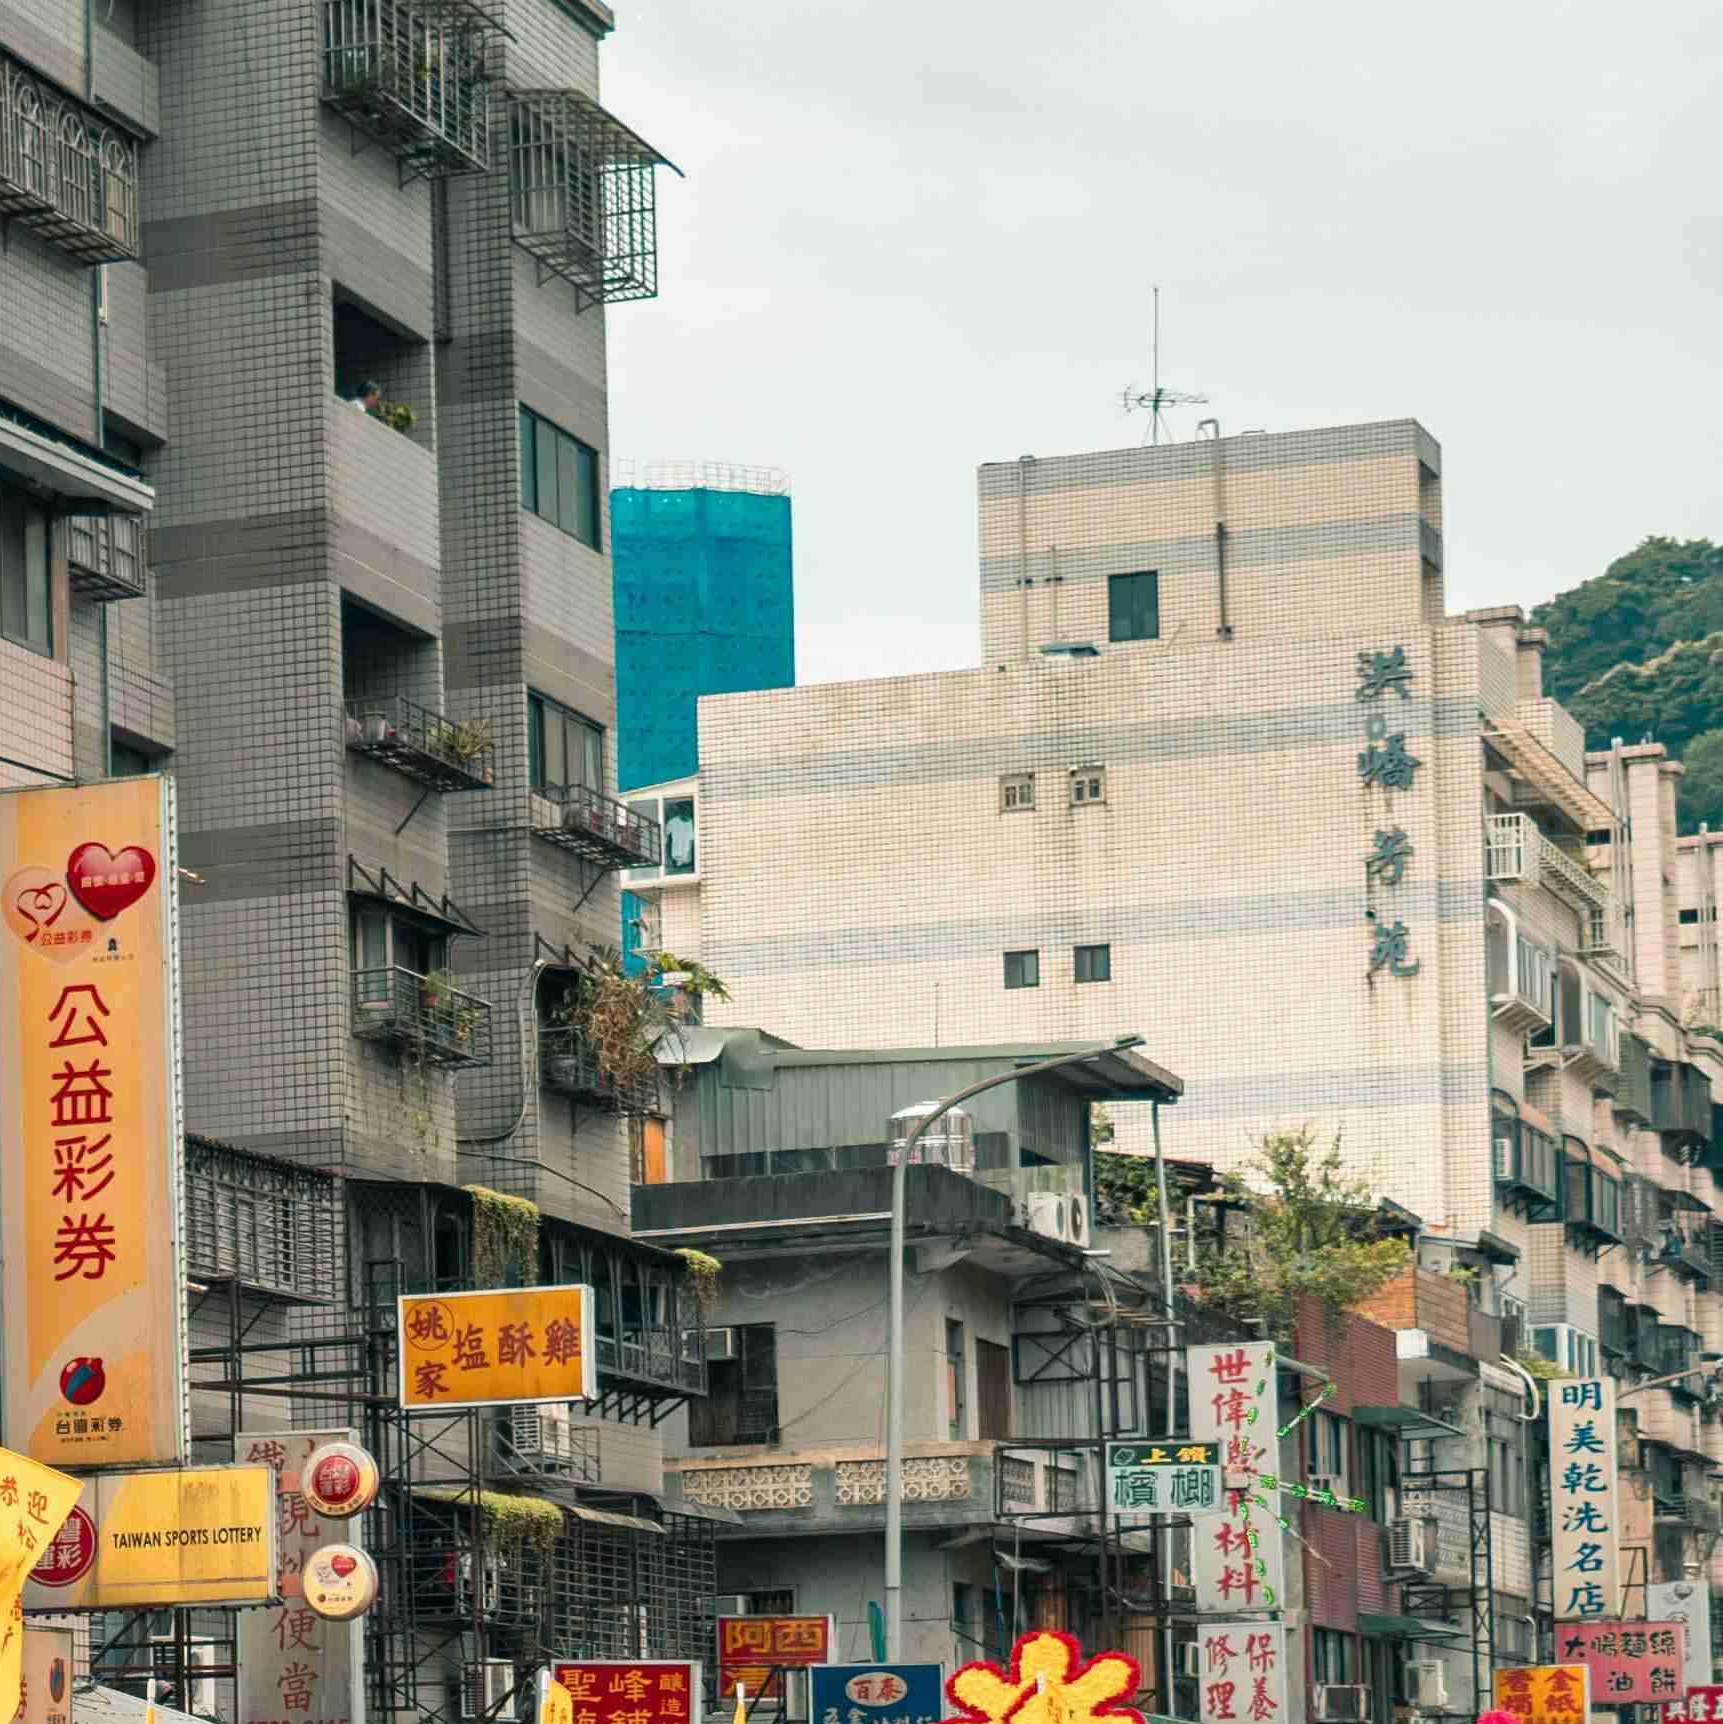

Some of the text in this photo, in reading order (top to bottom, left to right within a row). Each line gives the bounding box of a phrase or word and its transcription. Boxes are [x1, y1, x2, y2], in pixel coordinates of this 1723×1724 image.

[47, 983, 117, 1282] 公益彩券
[113, 1525, 262, 1549] TAIWAN SPORTS LOTTERY
[1114, 1468, 1215, 1508] 檳榔
[1561, 1381, 1609, 1617] 明美乾洗名店
